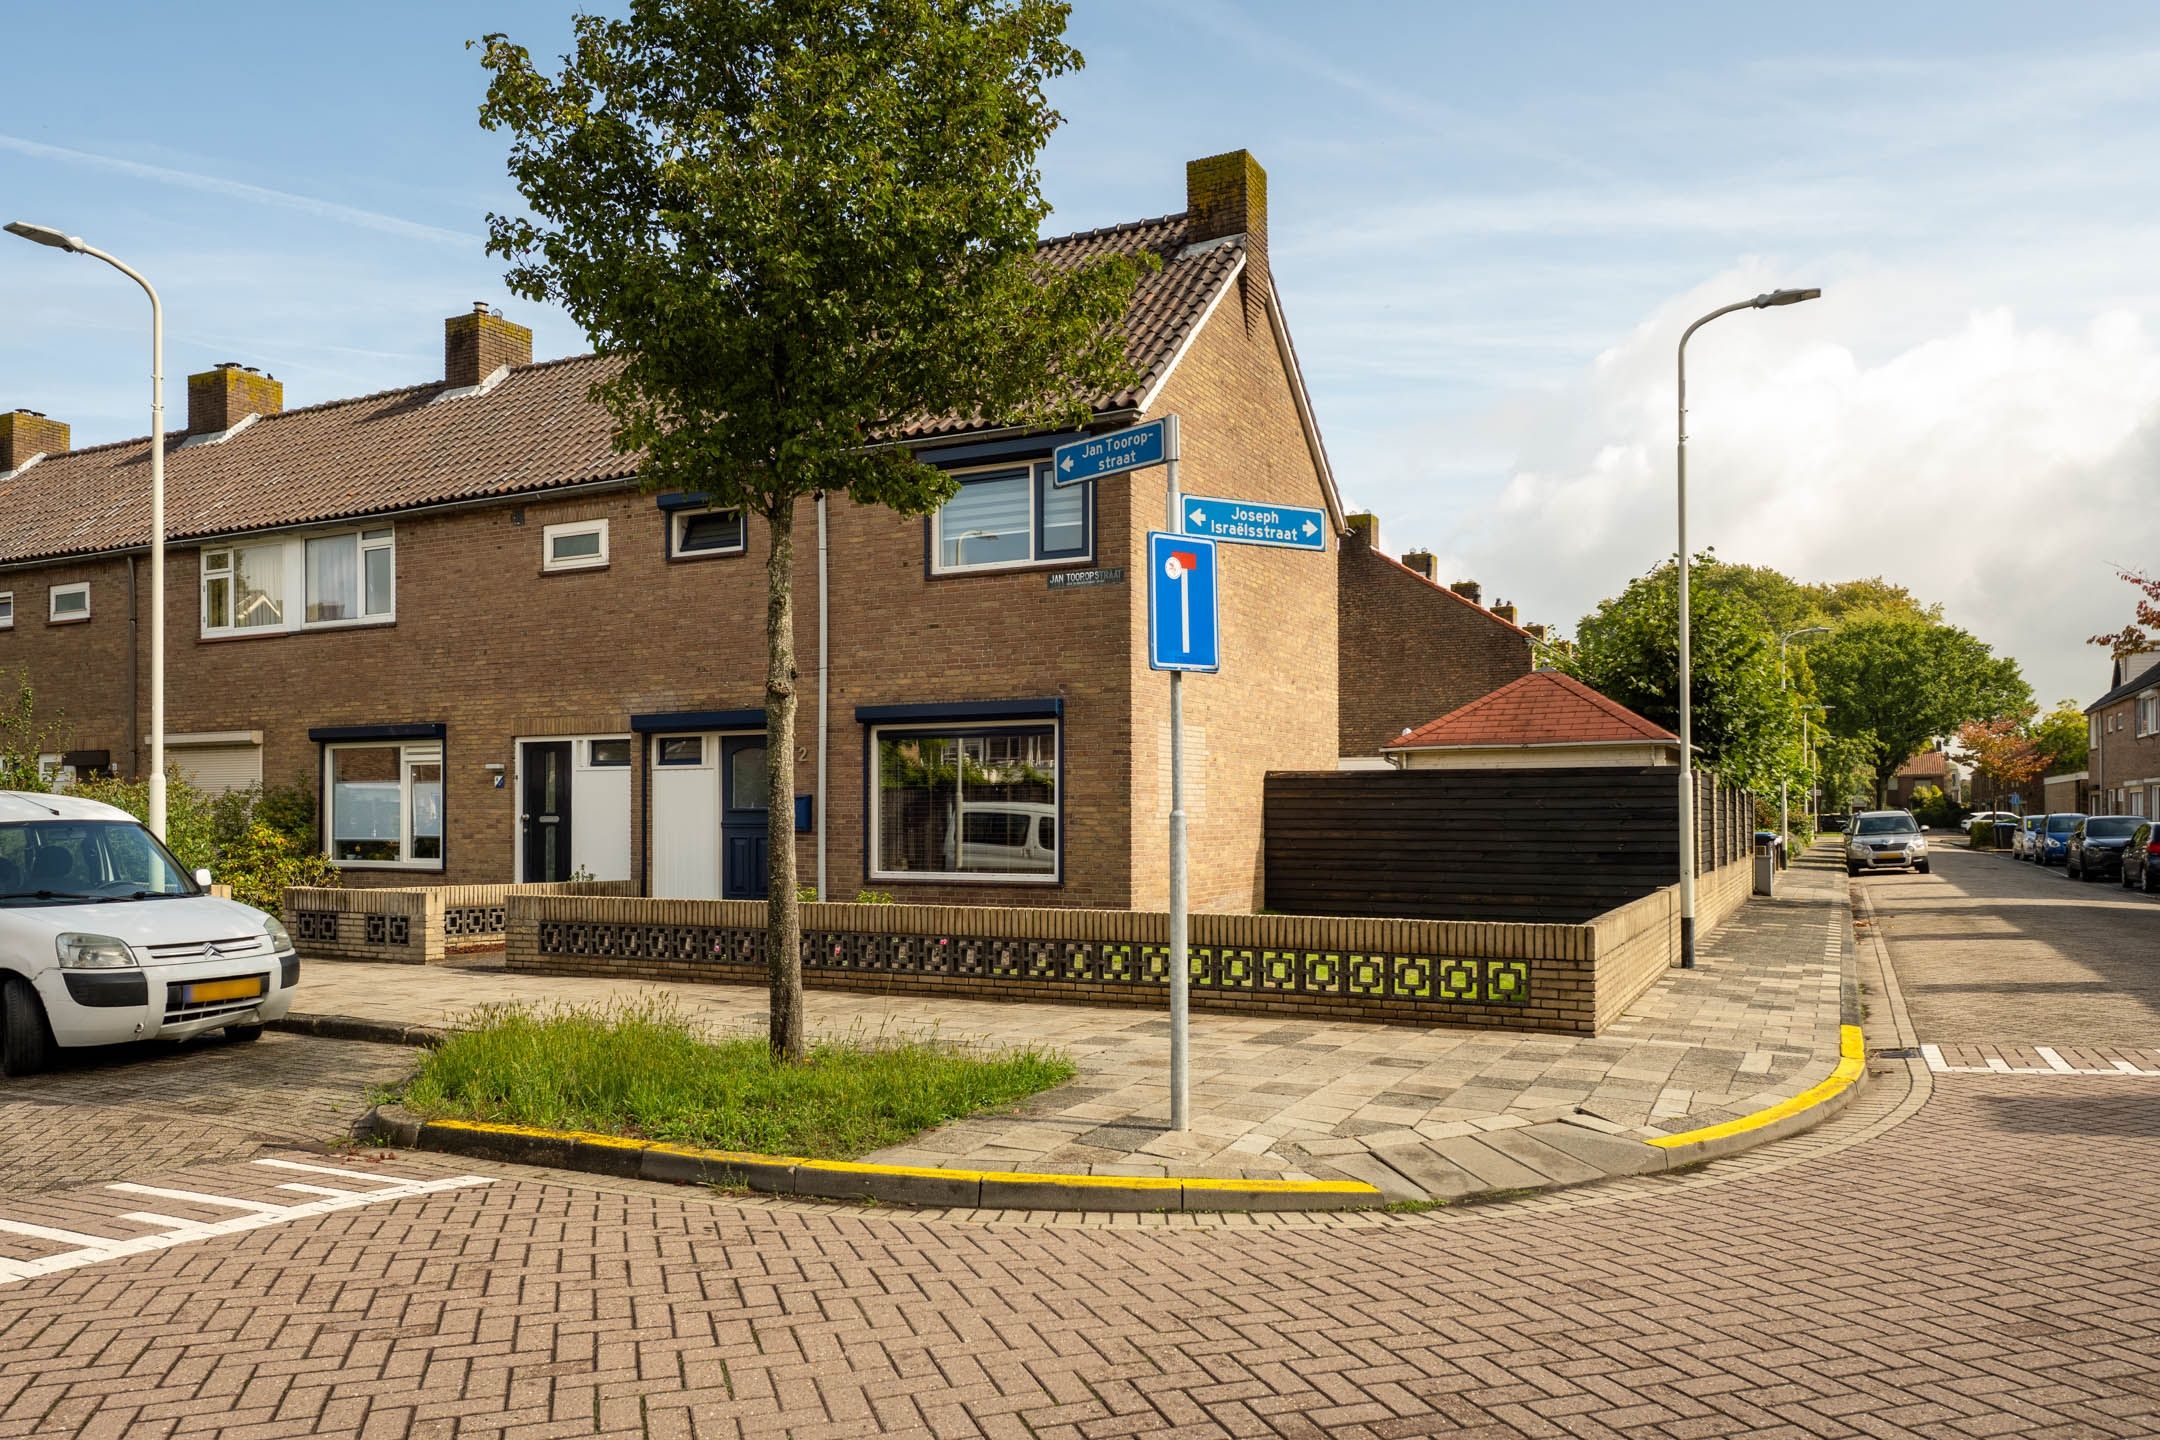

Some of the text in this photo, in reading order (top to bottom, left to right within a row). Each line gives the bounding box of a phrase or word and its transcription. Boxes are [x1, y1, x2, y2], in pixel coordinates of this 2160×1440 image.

[1082, 432, 1154, 458] Jan Toorop-
[1098, 450, 1136, 471] straat
[1231, 506, 1279, 526] Joseph
[1211, 519, 1298, 541] Israëlsstraat
[1049, 574, 1064, 584] JAN
[1066, 570, 1121, 582] TOOROPSTRAAT
[799, 746, 807, 762] 2
